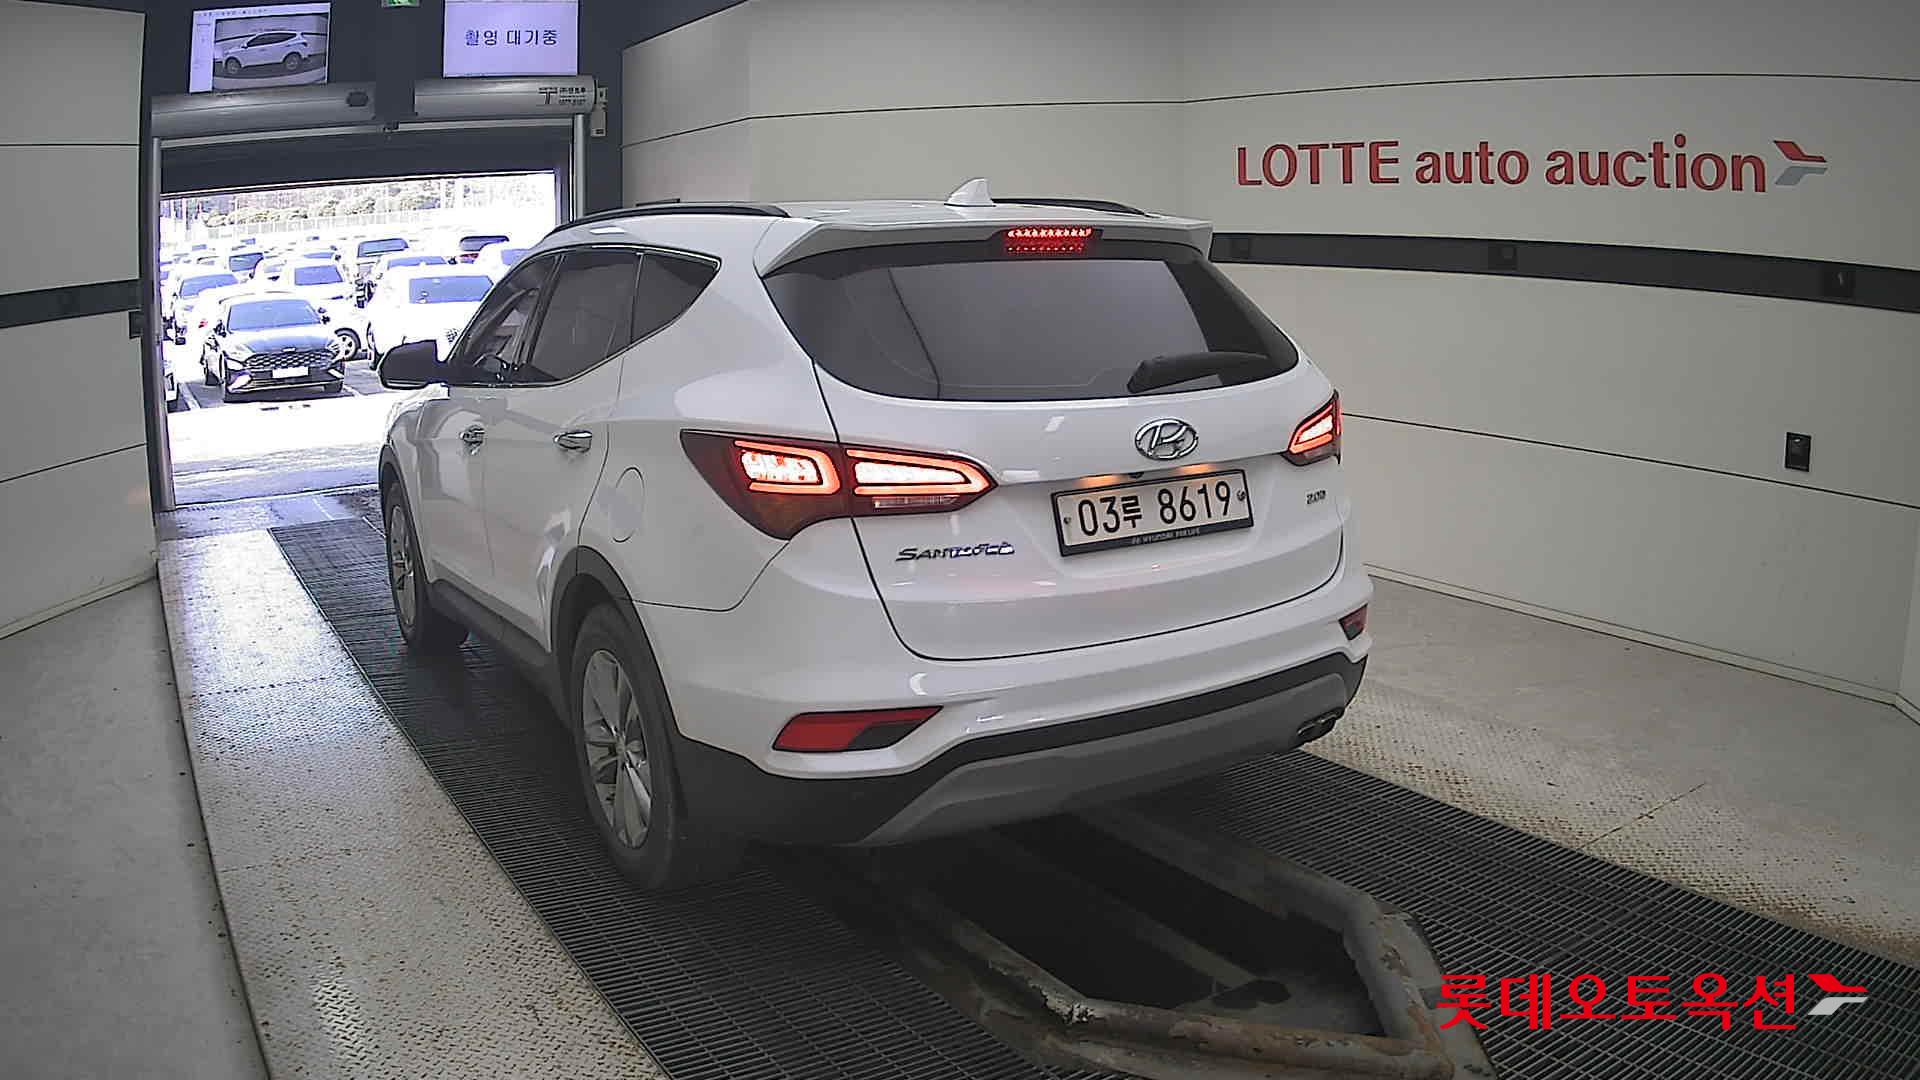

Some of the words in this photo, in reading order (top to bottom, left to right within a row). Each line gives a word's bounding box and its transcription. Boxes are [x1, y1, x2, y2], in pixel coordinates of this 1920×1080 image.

[506, 29, 558, 46] 대기중
[1237, 141, 1399, 187] LOTTE
[1415, 141, 1529, 185] auto
[1545, 134, 1767, 193] auction
[1078, 495, 1142, 536] 03루
[1157, 480, 1231, 524] 8619
